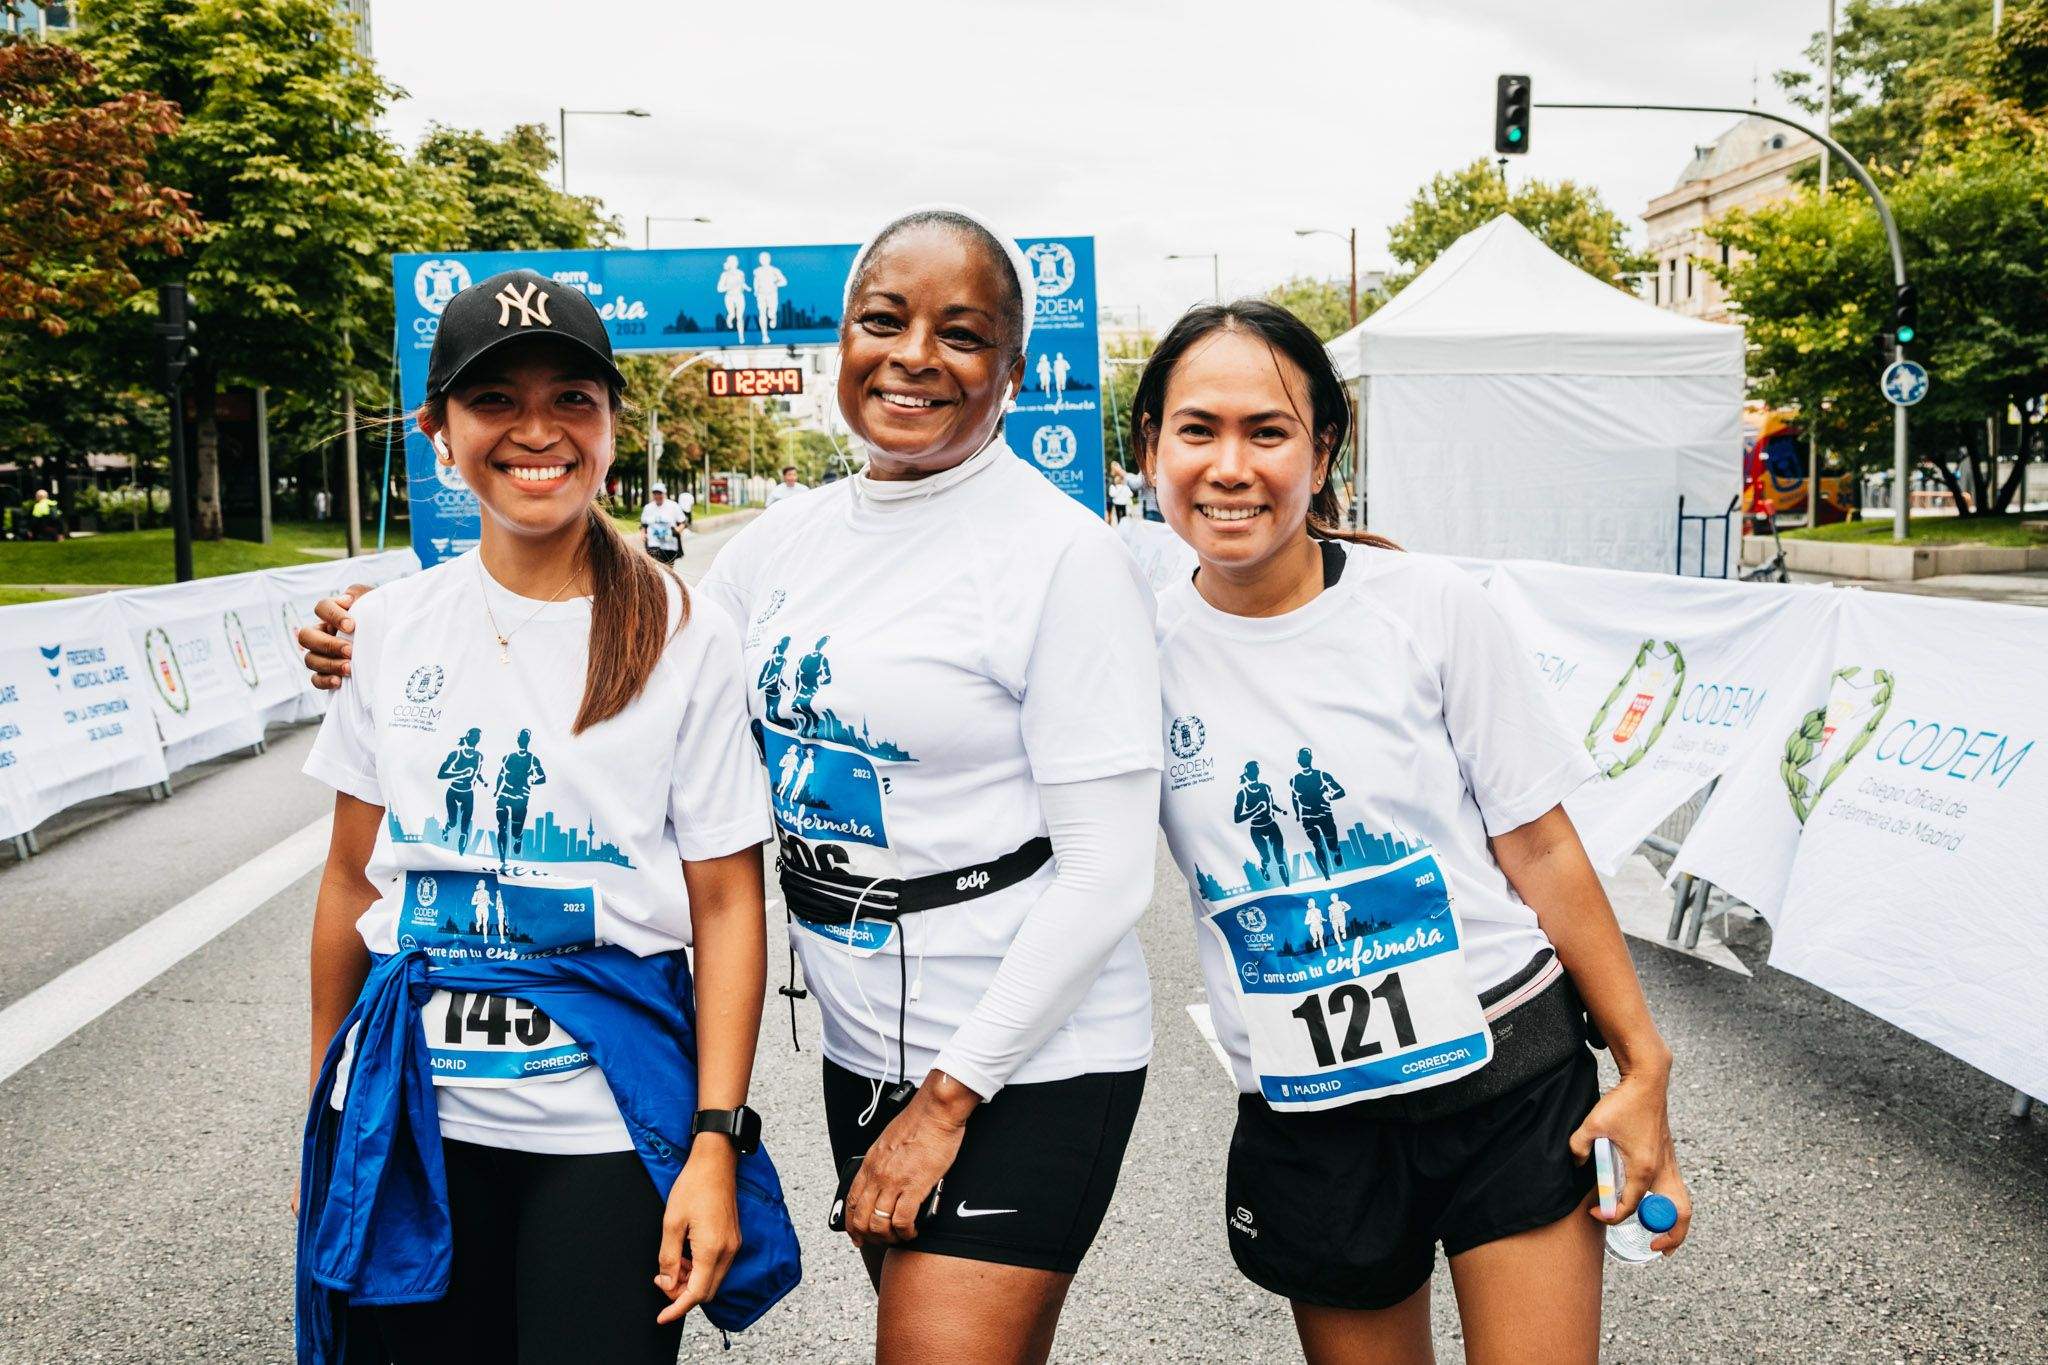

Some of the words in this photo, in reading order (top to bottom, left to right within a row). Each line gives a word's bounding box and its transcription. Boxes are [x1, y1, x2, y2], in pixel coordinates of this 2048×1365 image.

[1034, 298, 1084, 315] ODEM
[616, 322, 647, 336] 2023
[393, 705, 442, 719] CODEM
[1682, 683, 1768, 731] CODEM
[1876, 718, 2036, 789] CODEM
[853, 768, 872, 779] 2023
[1170, 757, 1213, 777] CODEM
[1858, 776, 1905, 803] Colegio
[1945, 800, 1968, 819] de
[782, 803, 875, 839] enfermera
[1910, 821, 1966, 851] Madrid
[956, 870, 990, 891] edp
[1415, 872, 1436, 888] 2023
[563, 902, 586, 913] 2023
[1243, 933, 1274, 943] CODEM
[470, 948, 482, 958] tu
[1263, 973, 1286, 984] corre
[1286, 970, 1308, 983] con
[1308, 964, 1324, 979] tu
[1325, 926, 1445, 977] enfermera
[1291, 972, 1419, 1068] 121
[430, 1057, 467, 1071] ADRID
[1293, 1079, 1342, 1096] MADRID
[1230, 1216, 1257, 1238] Kalenji
